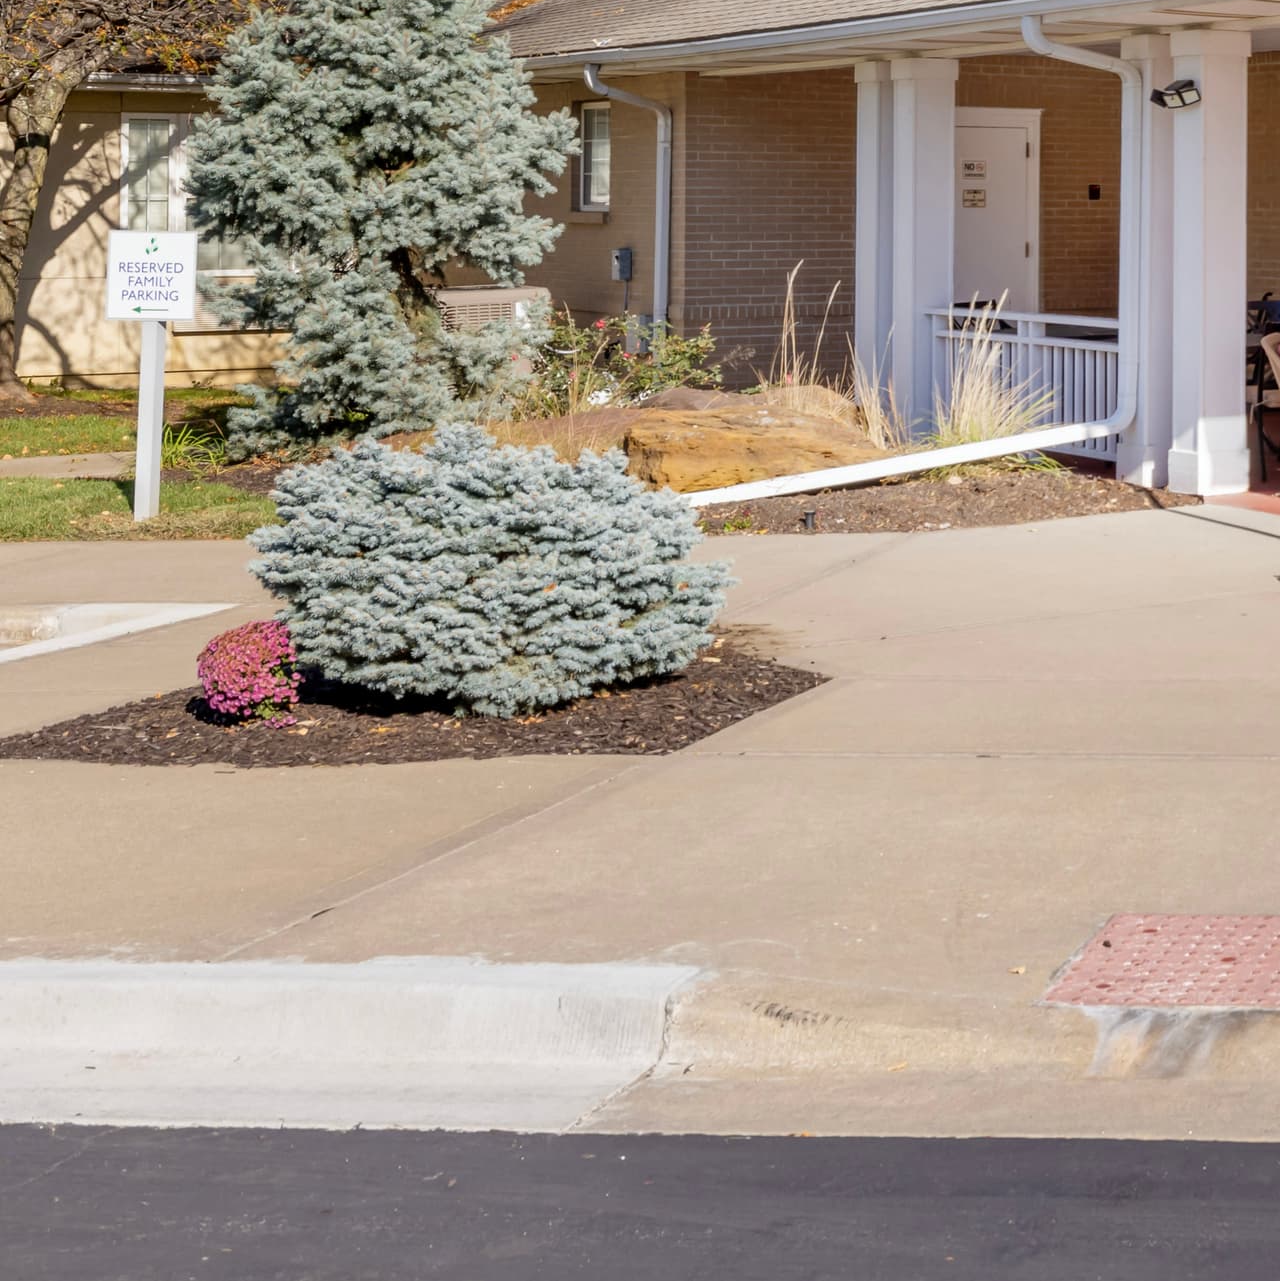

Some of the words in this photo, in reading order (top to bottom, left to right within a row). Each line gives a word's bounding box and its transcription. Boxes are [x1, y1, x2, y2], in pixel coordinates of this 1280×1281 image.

[118, 262, 184, 274] RESERVED
[128, 276, 174, 287] FAMILY
[121, 289, 179, 301] PARKING
